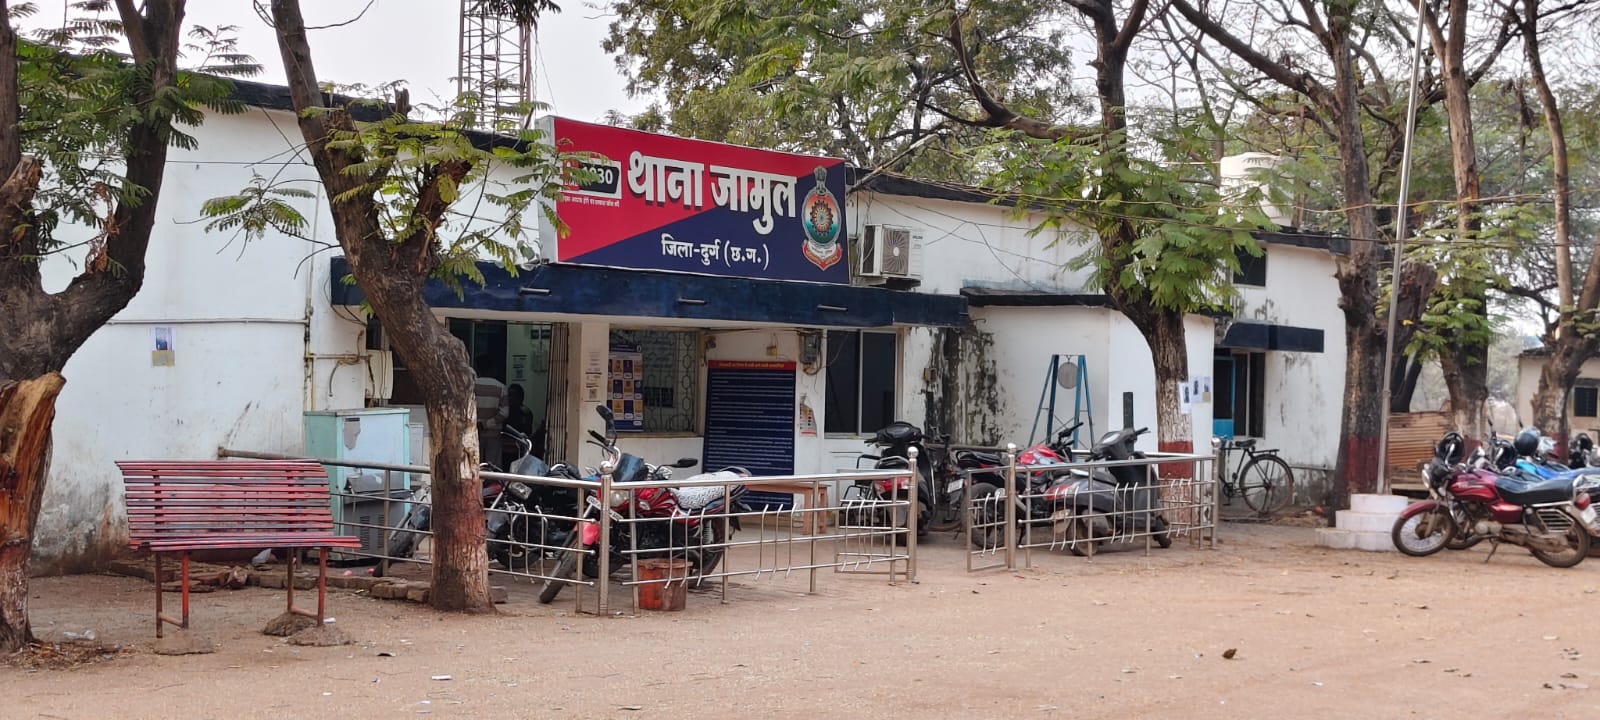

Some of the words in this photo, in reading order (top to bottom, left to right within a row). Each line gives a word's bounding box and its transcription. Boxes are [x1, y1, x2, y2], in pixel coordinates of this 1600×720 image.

[628, 151, 705, 207] थाना
[710, 164, 798, 235] जामुल
[661, 233, 721, 266] जिला-दुर्ग
[724, 240, 770, 271] (छ.ग.)
